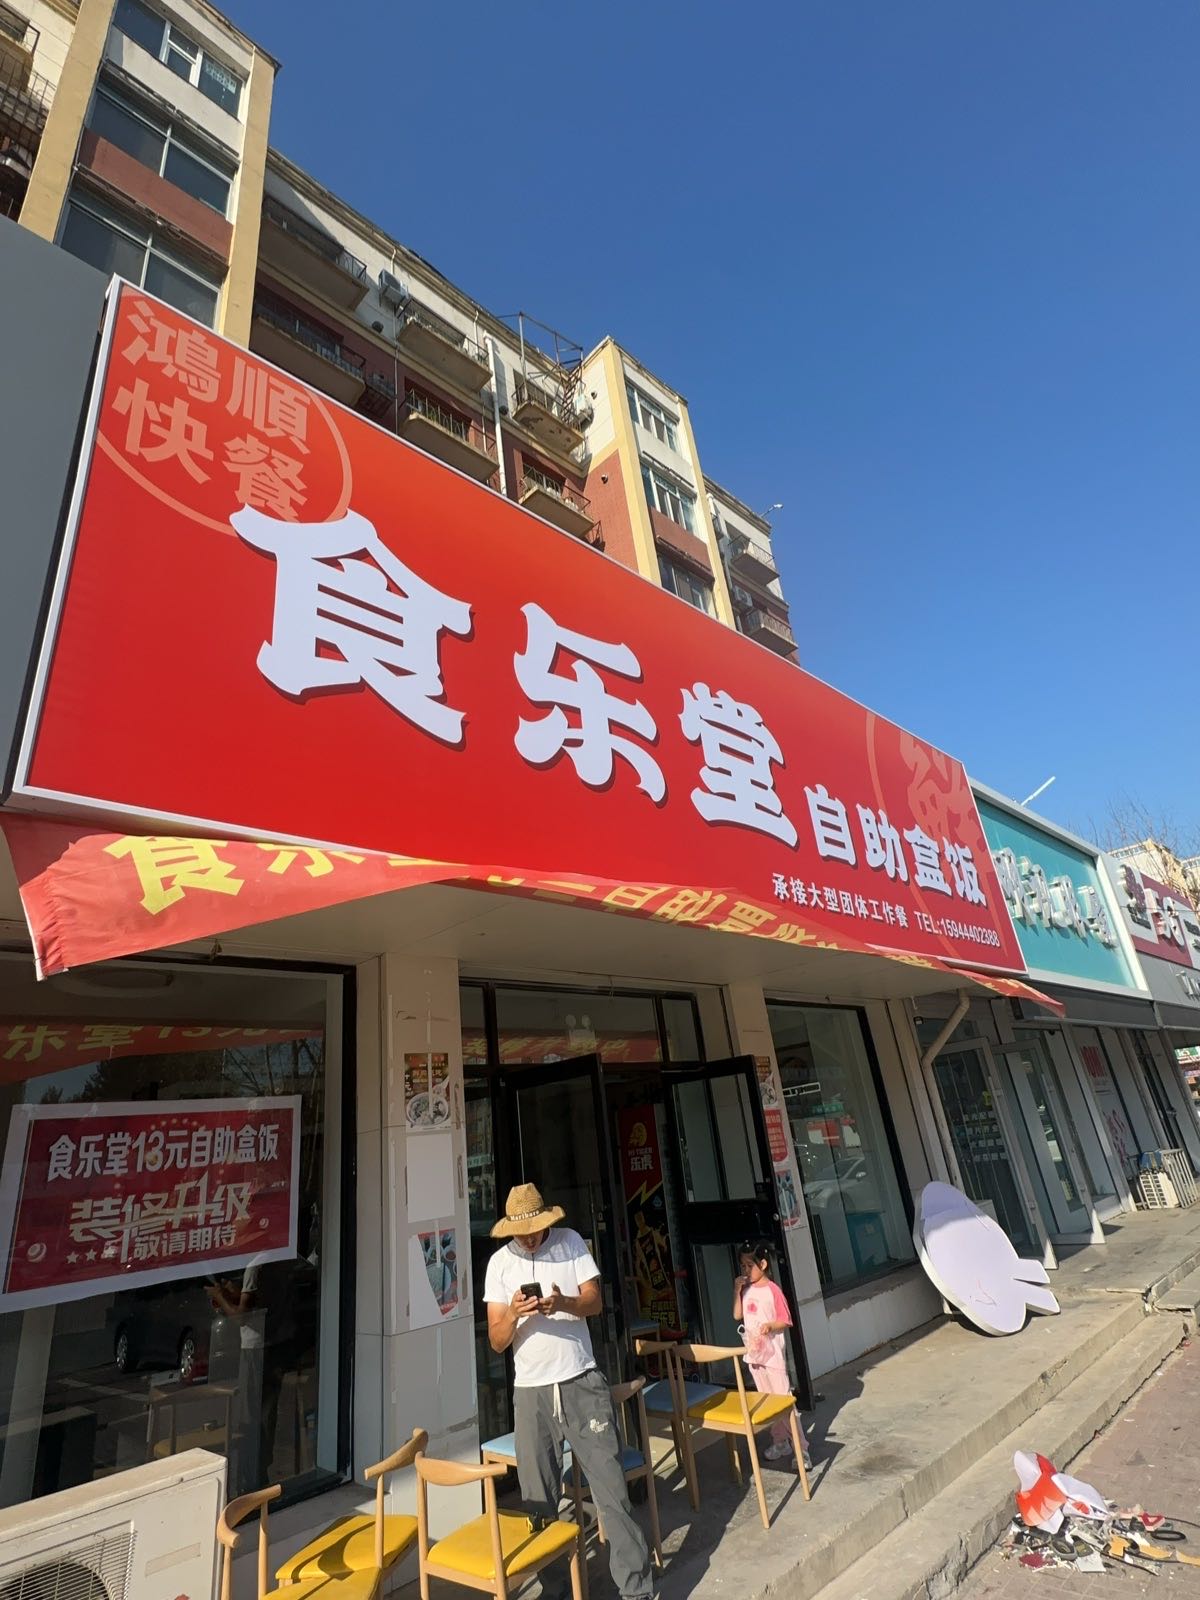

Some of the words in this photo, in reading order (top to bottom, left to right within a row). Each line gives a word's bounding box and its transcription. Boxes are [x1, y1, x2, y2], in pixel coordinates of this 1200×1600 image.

[112, 378, 309, 524] 快餐
[229, 502, 798, 849] 食乐堂
[804, 783, 987, 906] 自助盒饭
[772, 872, 909, 929] 承接大型团体工作餐
[913, 909, 1001, 947] TEL:15944402388
[47, 1123, 280, 1183] 食乐堂13元自助盒饭
[69, 1170, 253, 1263] 装修升级
[133, 1224, 237, 1261] 敬请期待
